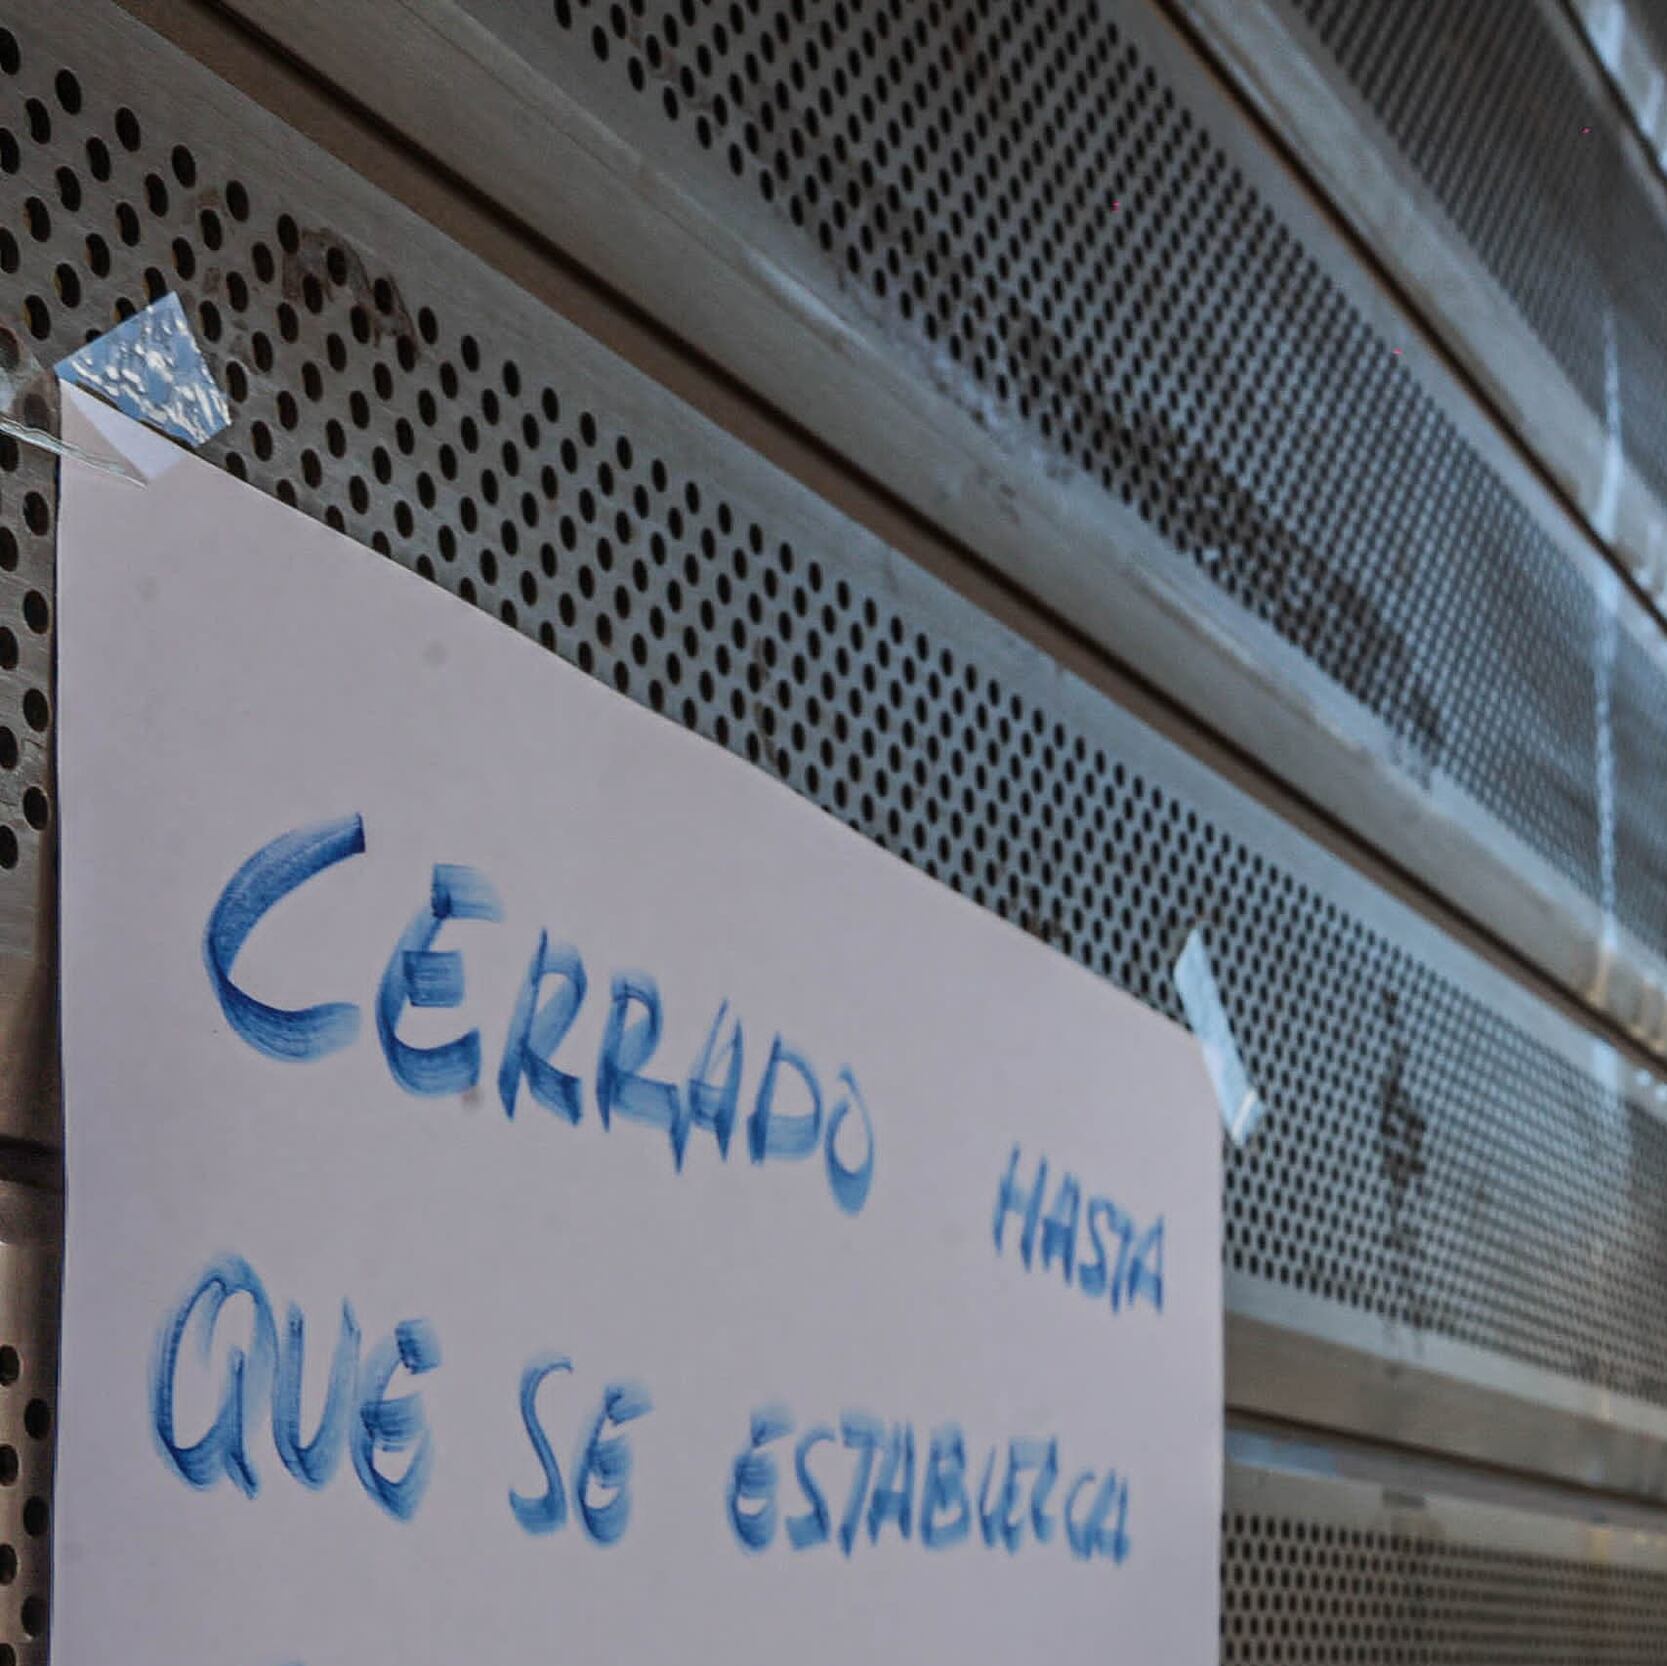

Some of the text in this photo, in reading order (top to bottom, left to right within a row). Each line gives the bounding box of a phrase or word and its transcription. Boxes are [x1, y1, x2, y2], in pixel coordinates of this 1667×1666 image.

[203, 813, 1166, 1315] CERRADO HASTA
[148, 1253, 441, 1522] QUE
[507, 1354, 653, 1548] SE
